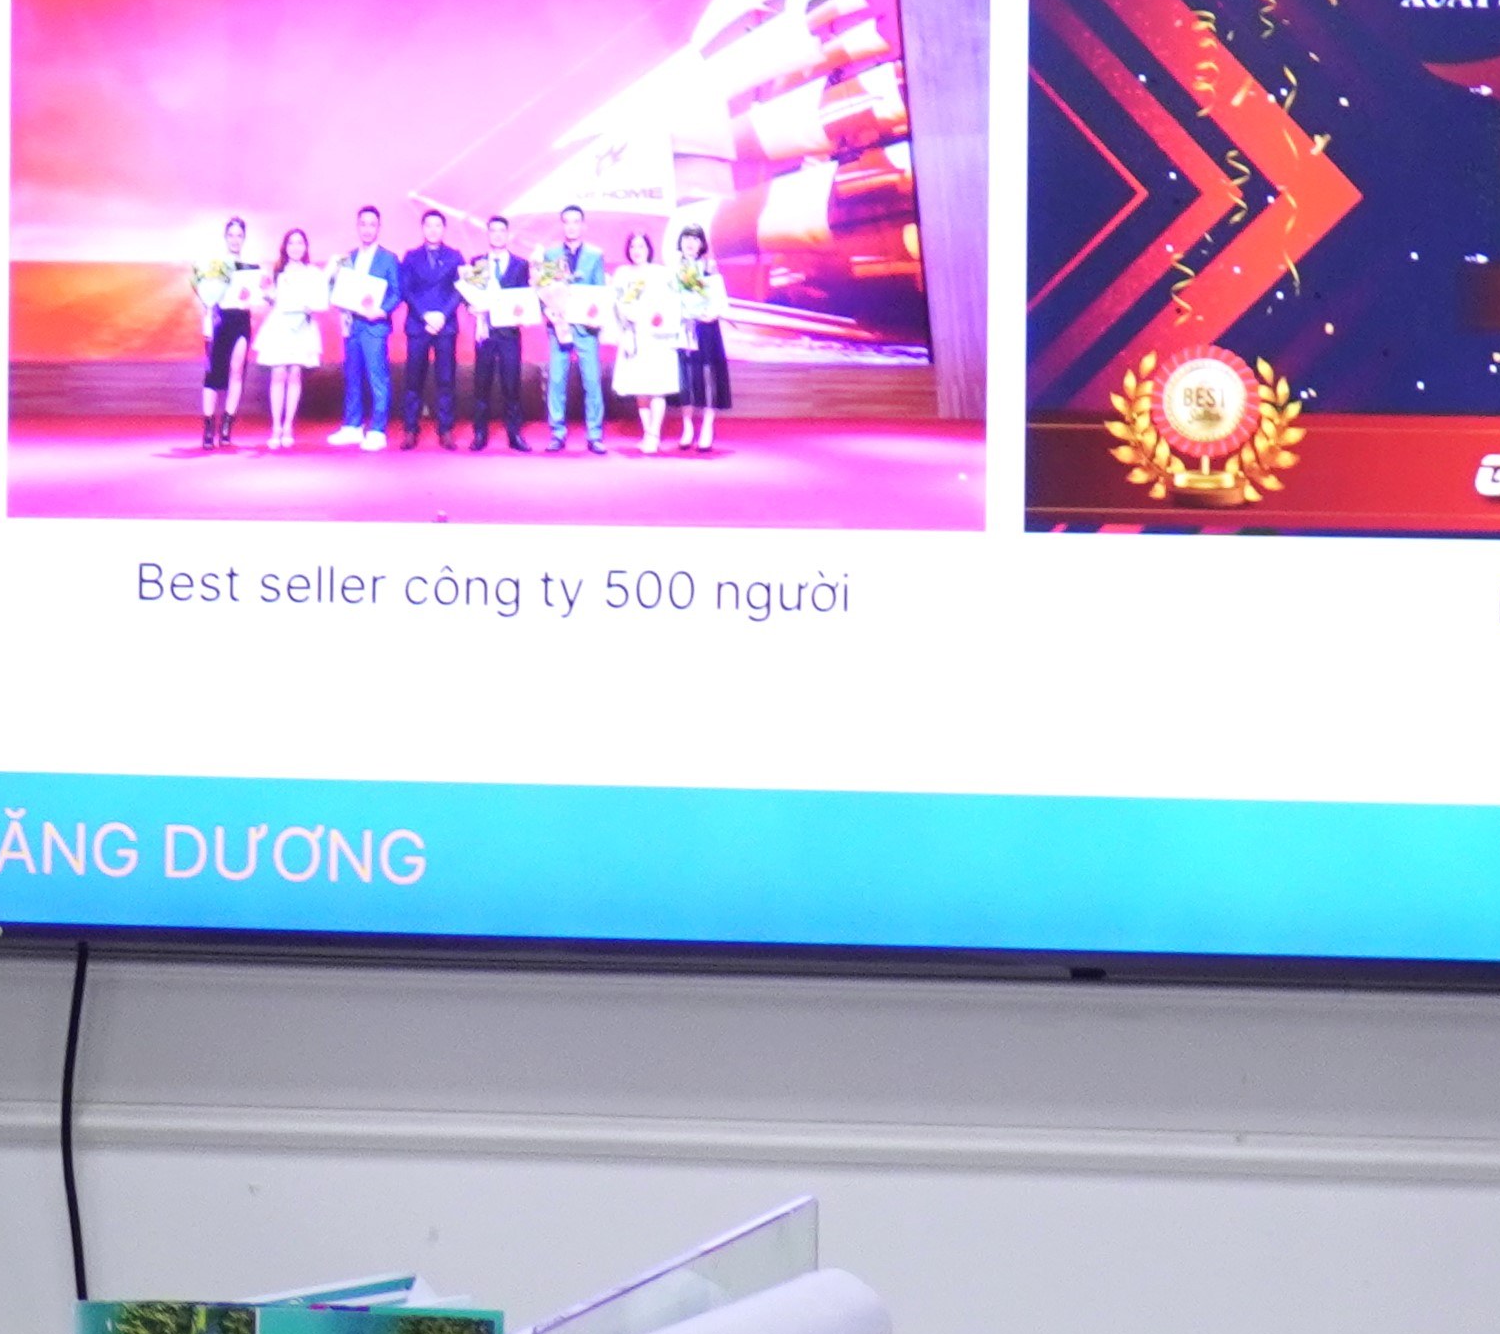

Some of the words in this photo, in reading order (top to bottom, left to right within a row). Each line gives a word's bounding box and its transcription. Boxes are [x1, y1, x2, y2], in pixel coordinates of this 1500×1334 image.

[1183, 386, 1226, 408] BEST
[138, 562, 240, 603] Best
[260, 565, 388, 605] seller
[404, 565, 521, 618] công
[540, 572, 584, 619] ty
[605, 570, 696, 610] 500
[716, 570, 850, 622] người
[163, 823, 428, 886] DƯƠNG
